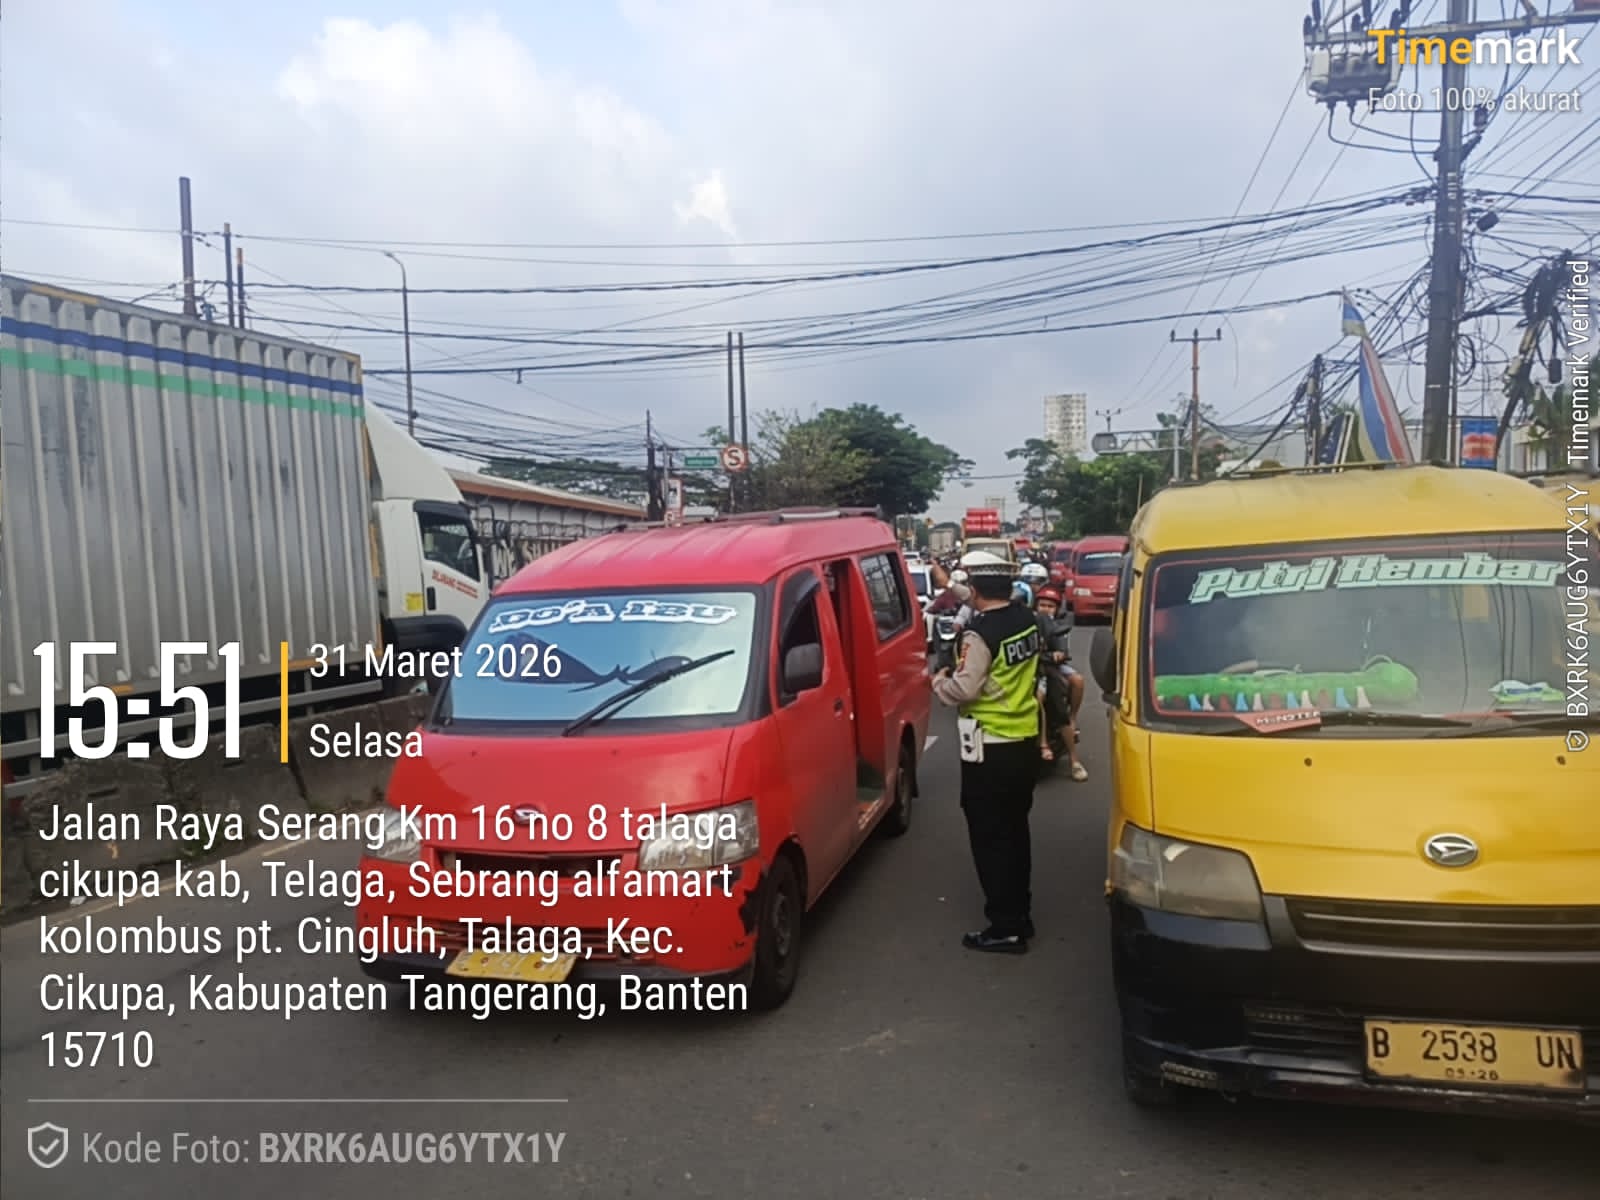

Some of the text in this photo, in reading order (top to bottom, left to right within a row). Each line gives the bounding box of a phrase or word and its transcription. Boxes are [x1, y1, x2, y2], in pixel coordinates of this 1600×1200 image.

[1189, 552, 1566, 603] Putri Kembar
[619, 600, 738, 625] IBU
[1372, 1027, 1579, 1070] B 2538 UN
